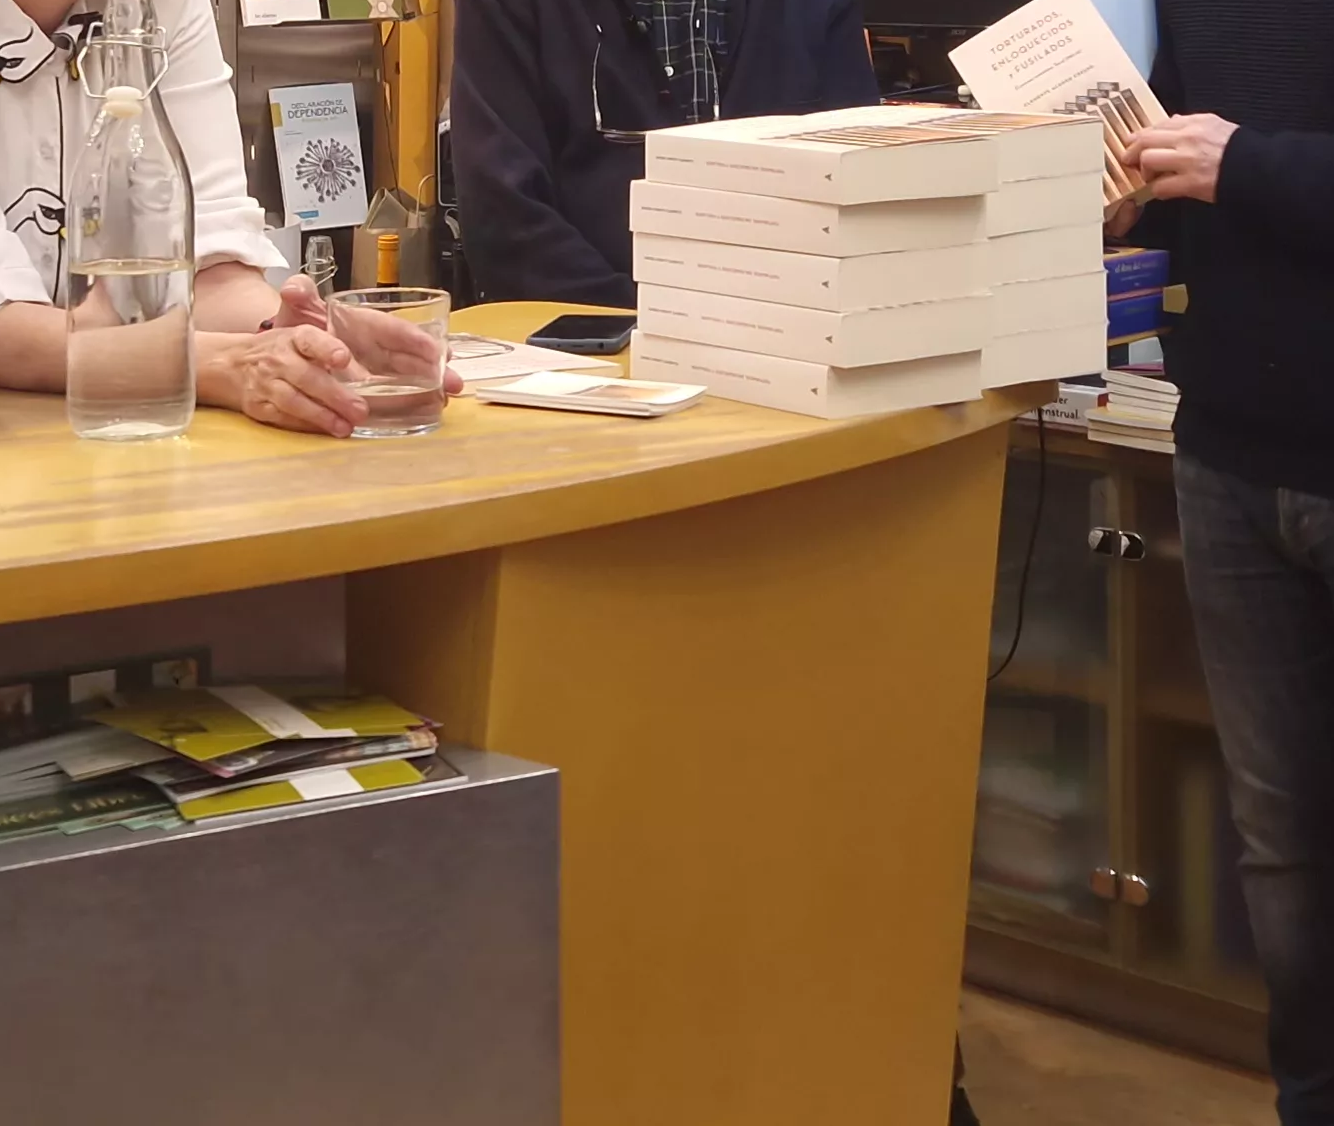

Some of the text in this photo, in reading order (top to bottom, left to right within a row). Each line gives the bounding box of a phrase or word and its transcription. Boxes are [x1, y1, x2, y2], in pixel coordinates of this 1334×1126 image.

[990, 11, 1063, 55] TORTURADOS,
[991, 19, 1074, 72] ENLOQUECIDOS
[1014, 35, 1073, 74] FUSILADOS
[288, 106, 348, 119] DEPENDENCIA
